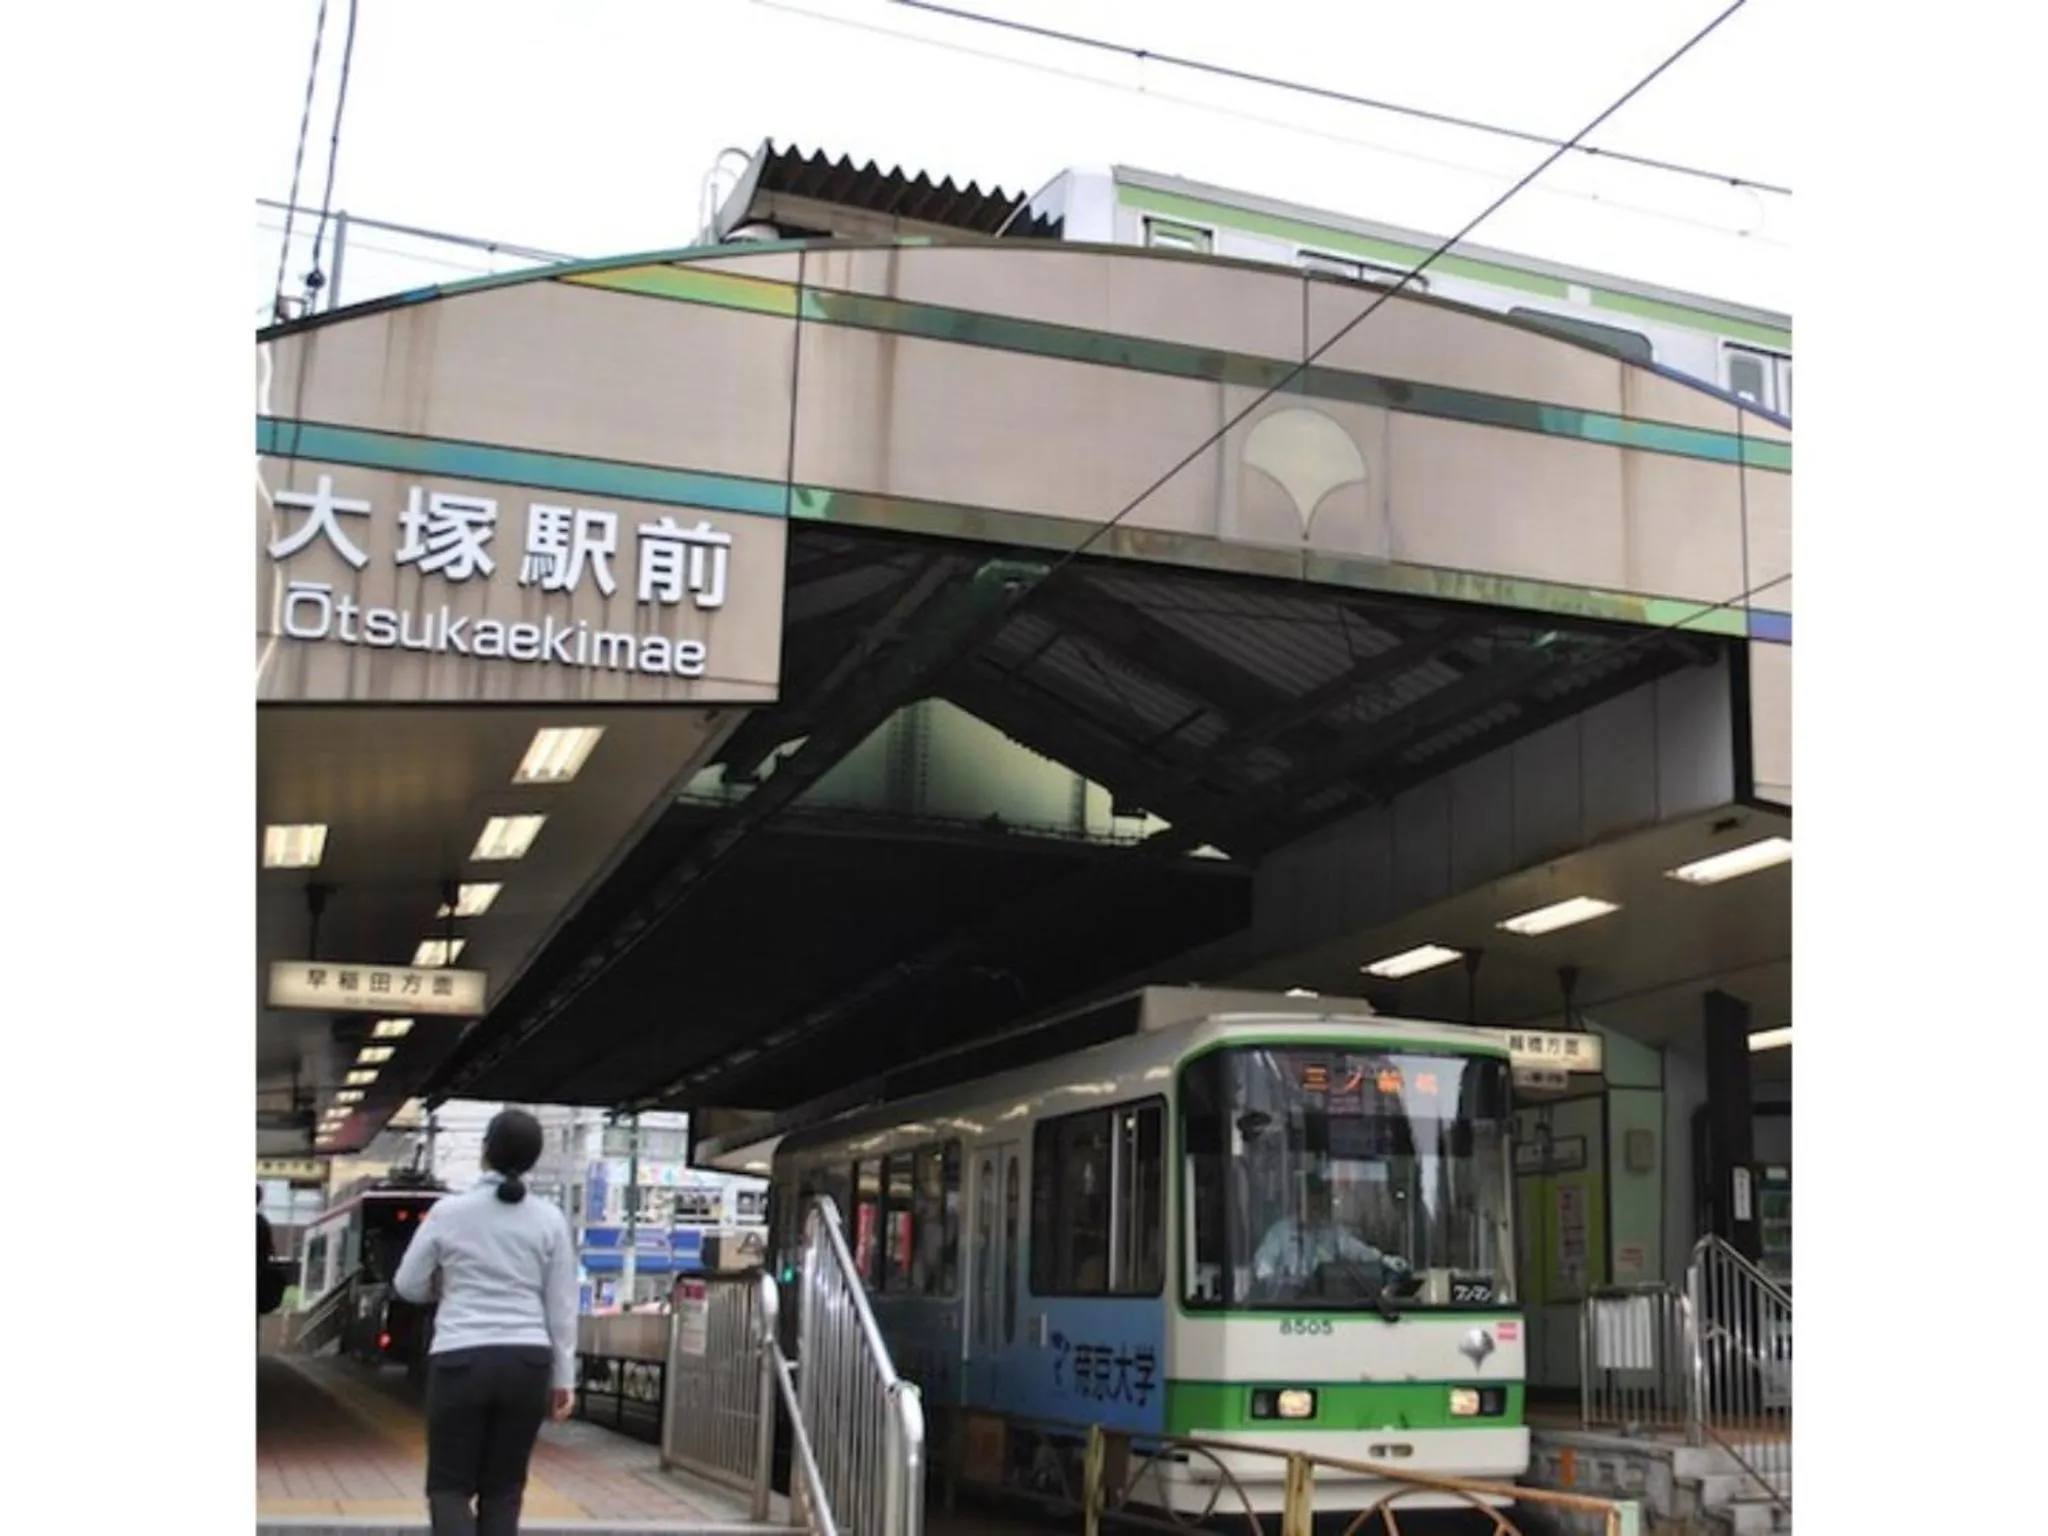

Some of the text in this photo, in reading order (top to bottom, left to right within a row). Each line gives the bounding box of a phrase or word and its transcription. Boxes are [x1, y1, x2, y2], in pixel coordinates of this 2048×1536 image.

[268, 475, 732, 608] 大塚駅前
[283, 581, 706, 677] Ōtsukaekimae
[306, 969, 454, 996] 早稲田方面
[1303, 1066, 1438, 1095] 三ノ
[1278, 1319, 1334, 1336] 8505
[1075, 1341, 1156, 1408] 帝京大学
